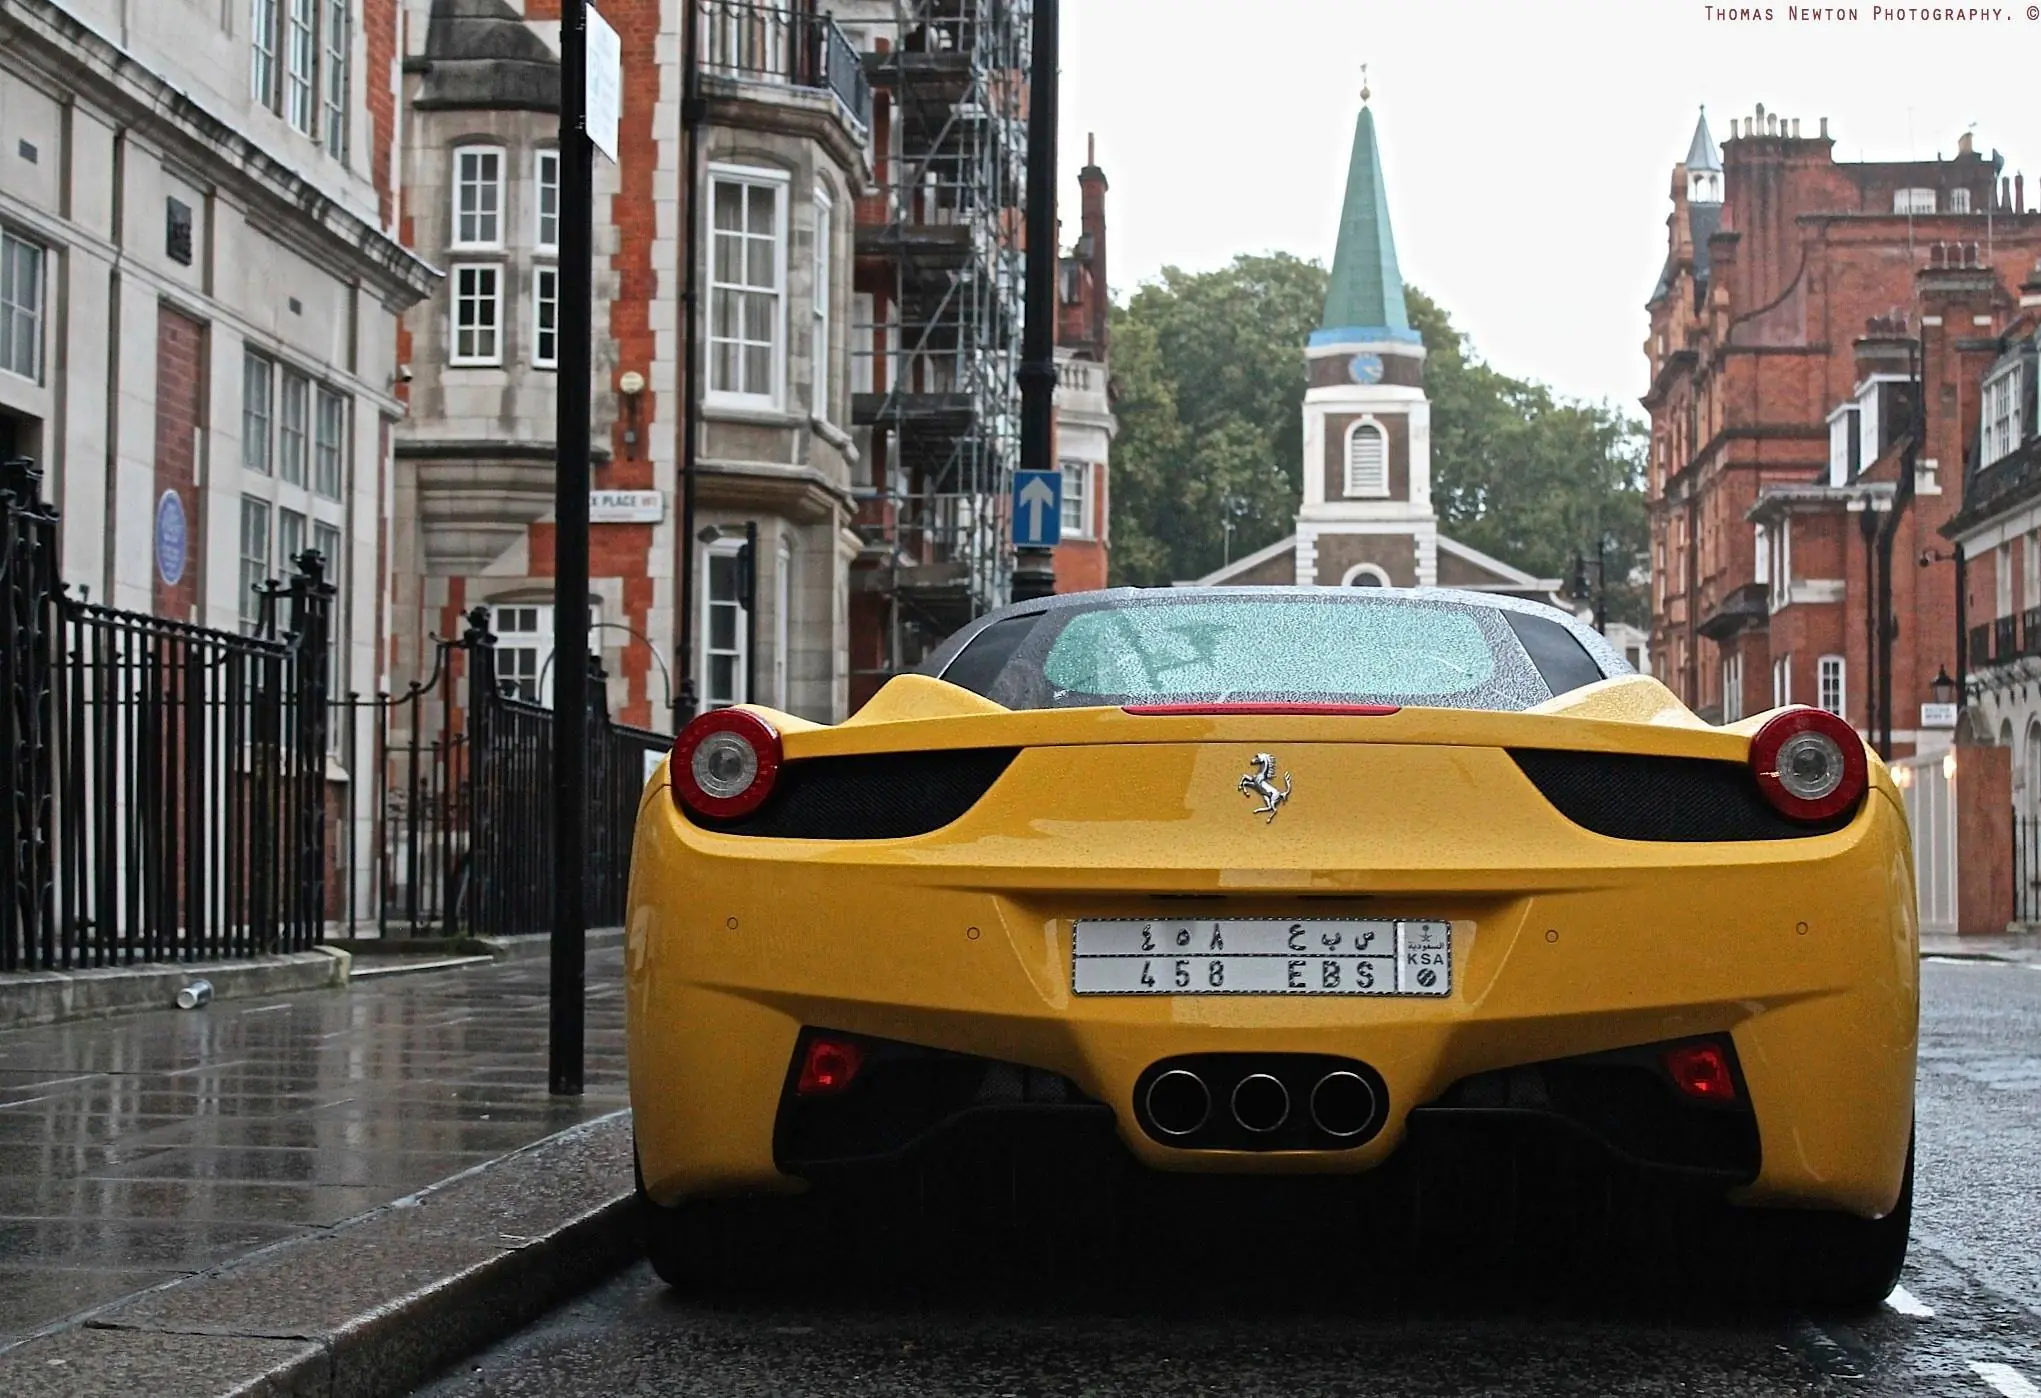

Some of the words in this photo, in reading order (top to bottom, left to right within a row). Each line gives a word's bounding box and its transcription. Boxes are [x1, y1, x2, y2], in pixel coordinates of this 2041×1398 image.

[602, 496, 636, 508] PLACE
[1407, 953, 1444, 965] KSA
[1140, 959, 1224, 988] 458
[1288, 959, 1374, 989] EBS
